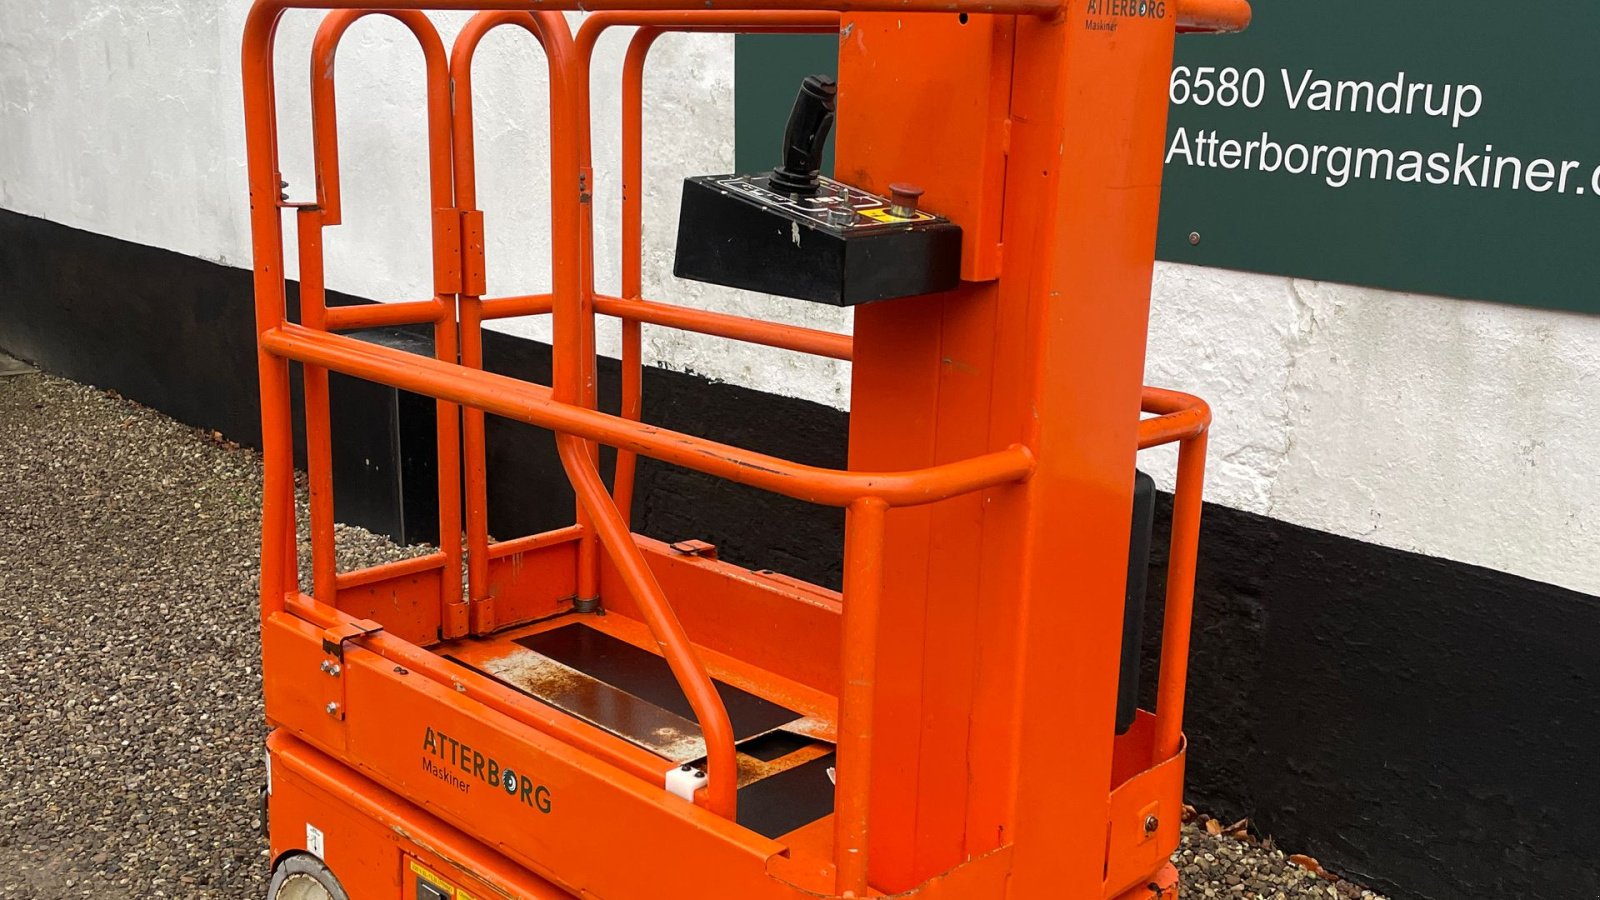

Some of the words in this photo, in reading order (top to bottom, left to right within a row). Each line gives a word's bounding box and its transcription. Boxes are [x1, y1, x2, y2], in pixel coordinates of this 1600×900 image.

[1085, 19, 1118, 31] Maskiner
[1169, 65, 1265, 108] 6580
[1281, 68, 1483, 128] Vamdrup
[422, 756, 471, 795] Maskiner
[423, 726, 552, 814] ATTERBORG
